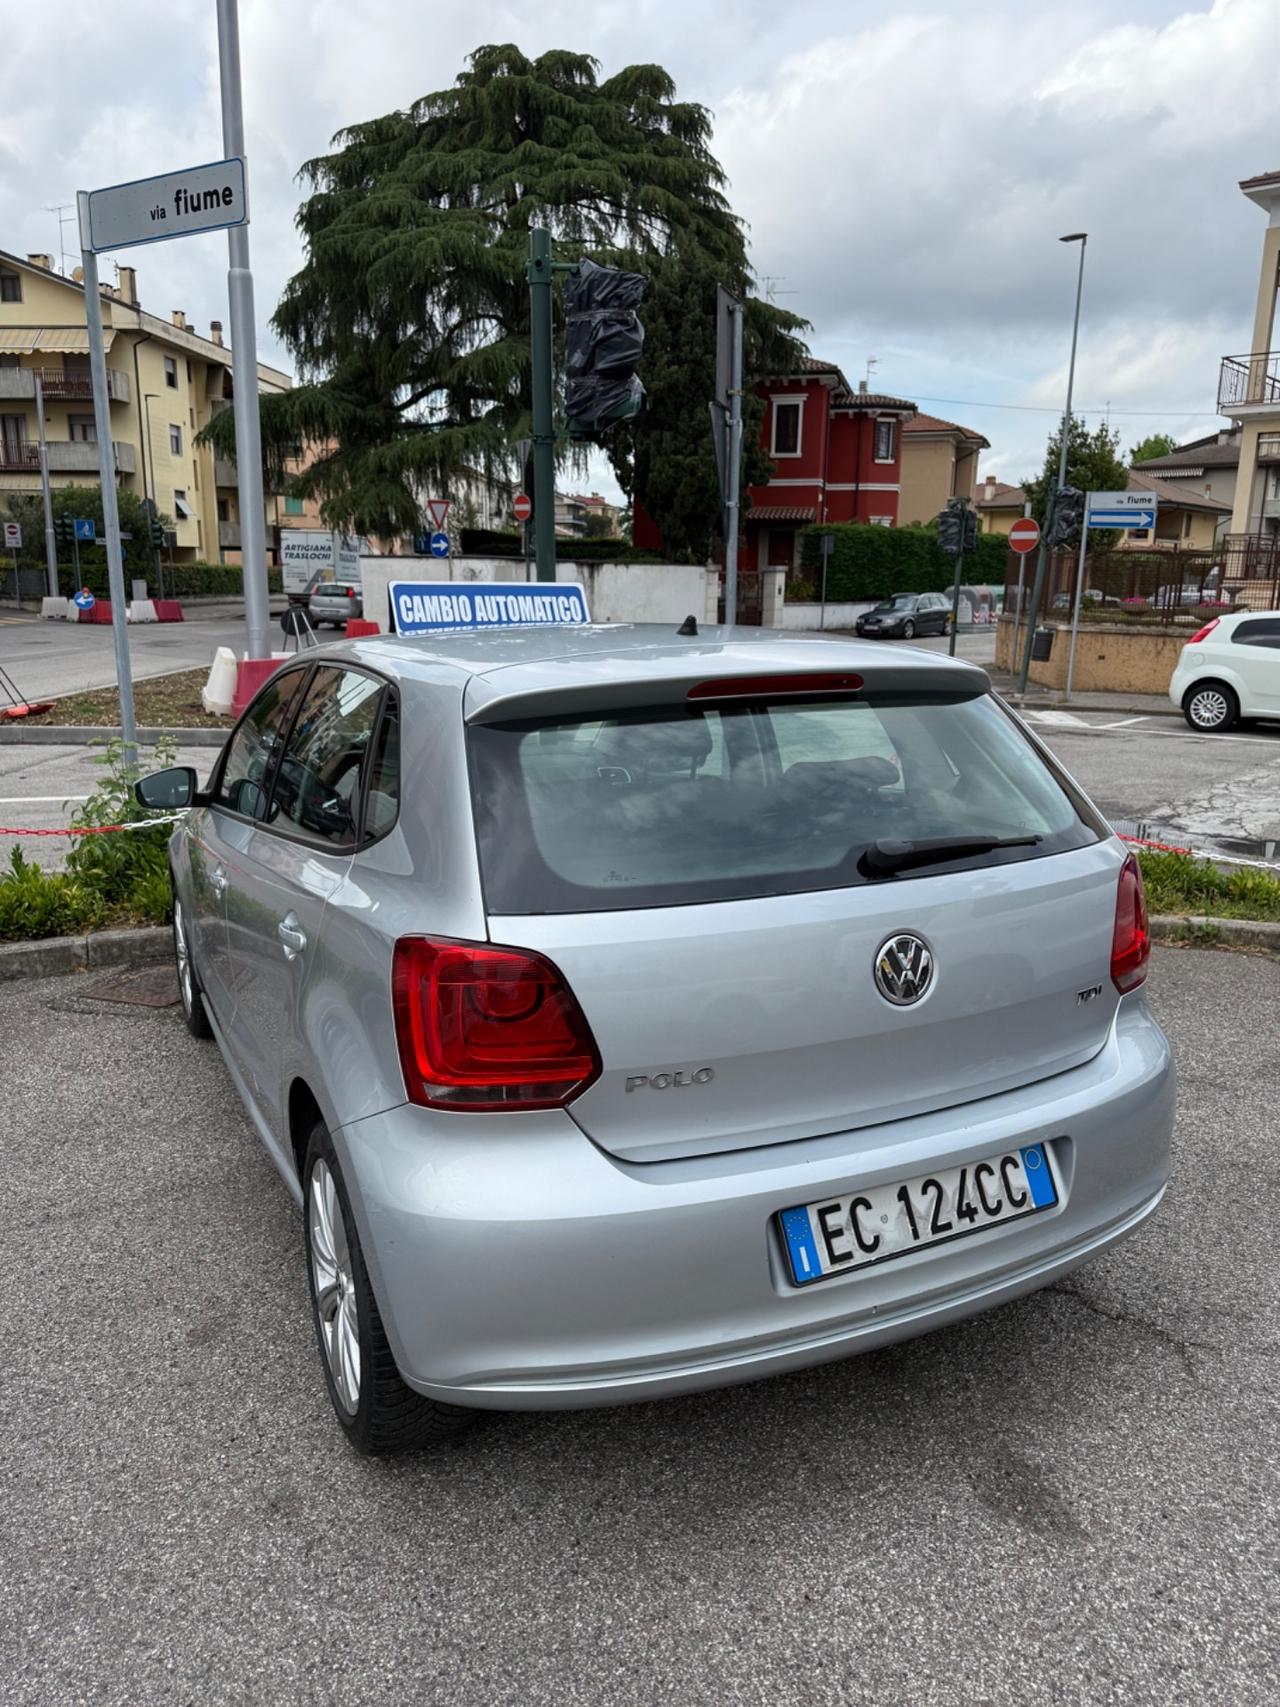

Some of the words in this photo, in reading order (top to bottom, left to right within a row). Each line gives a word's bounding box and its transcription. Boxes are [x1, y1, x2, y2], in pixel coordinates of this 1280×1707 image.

[150, 205, 166, 221] via
[174, 186, 233, 216] fiume
[1127, 496, 1152, 504] fiume
[284, 544, 332, 552] ARTIGIANA
[284, 552, 331, 560] TRASLOCHI
[400, 595, 472, 623] CAMBIO
[476, 595, 582, 622] AUTOMATICO
[625, 1067, 715, 1092] POLO
[817, 1196, 880, 1265] EC
[897, 1156, 1027, 1240] 124CC
